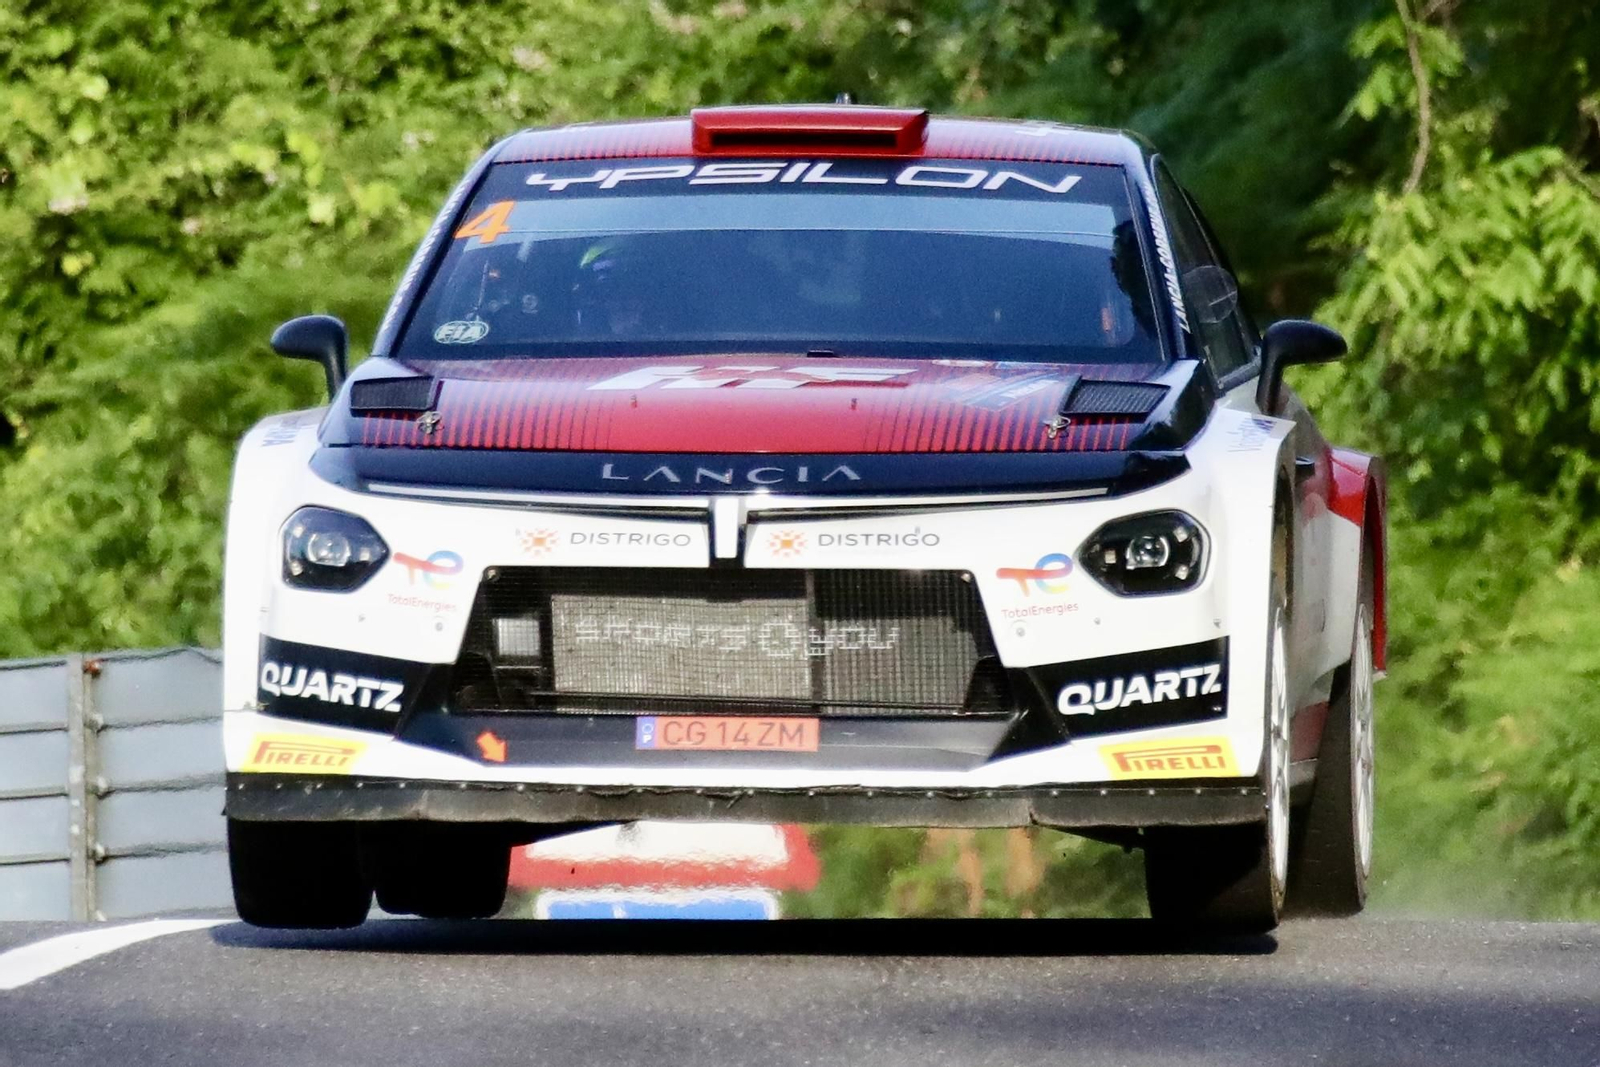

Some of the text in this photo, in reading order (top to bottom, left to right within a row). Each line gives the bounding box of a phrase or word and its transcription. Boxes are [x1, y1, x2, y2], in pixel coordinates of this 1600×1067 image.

[525, 161, 1082, 194] YPSILON
[454, 199, 516, 245] 4
[601, 463, 861, 484] LANCIA
[570, 531, 691, 547] DISTRIGO
[818, 532, 940, 547] DISTRIGO
[388, 593, 457, 613] TotalEnergies
[1001, 602, 1079, 619] TotalEnergies
[260, 661, 405, 713] QUARTZ
[1057, 663, 1222, 716] QUARTZ
[252, 740, 357, 767] PIRELLI
[1112, 744, 1227, 772] PIRELLI
